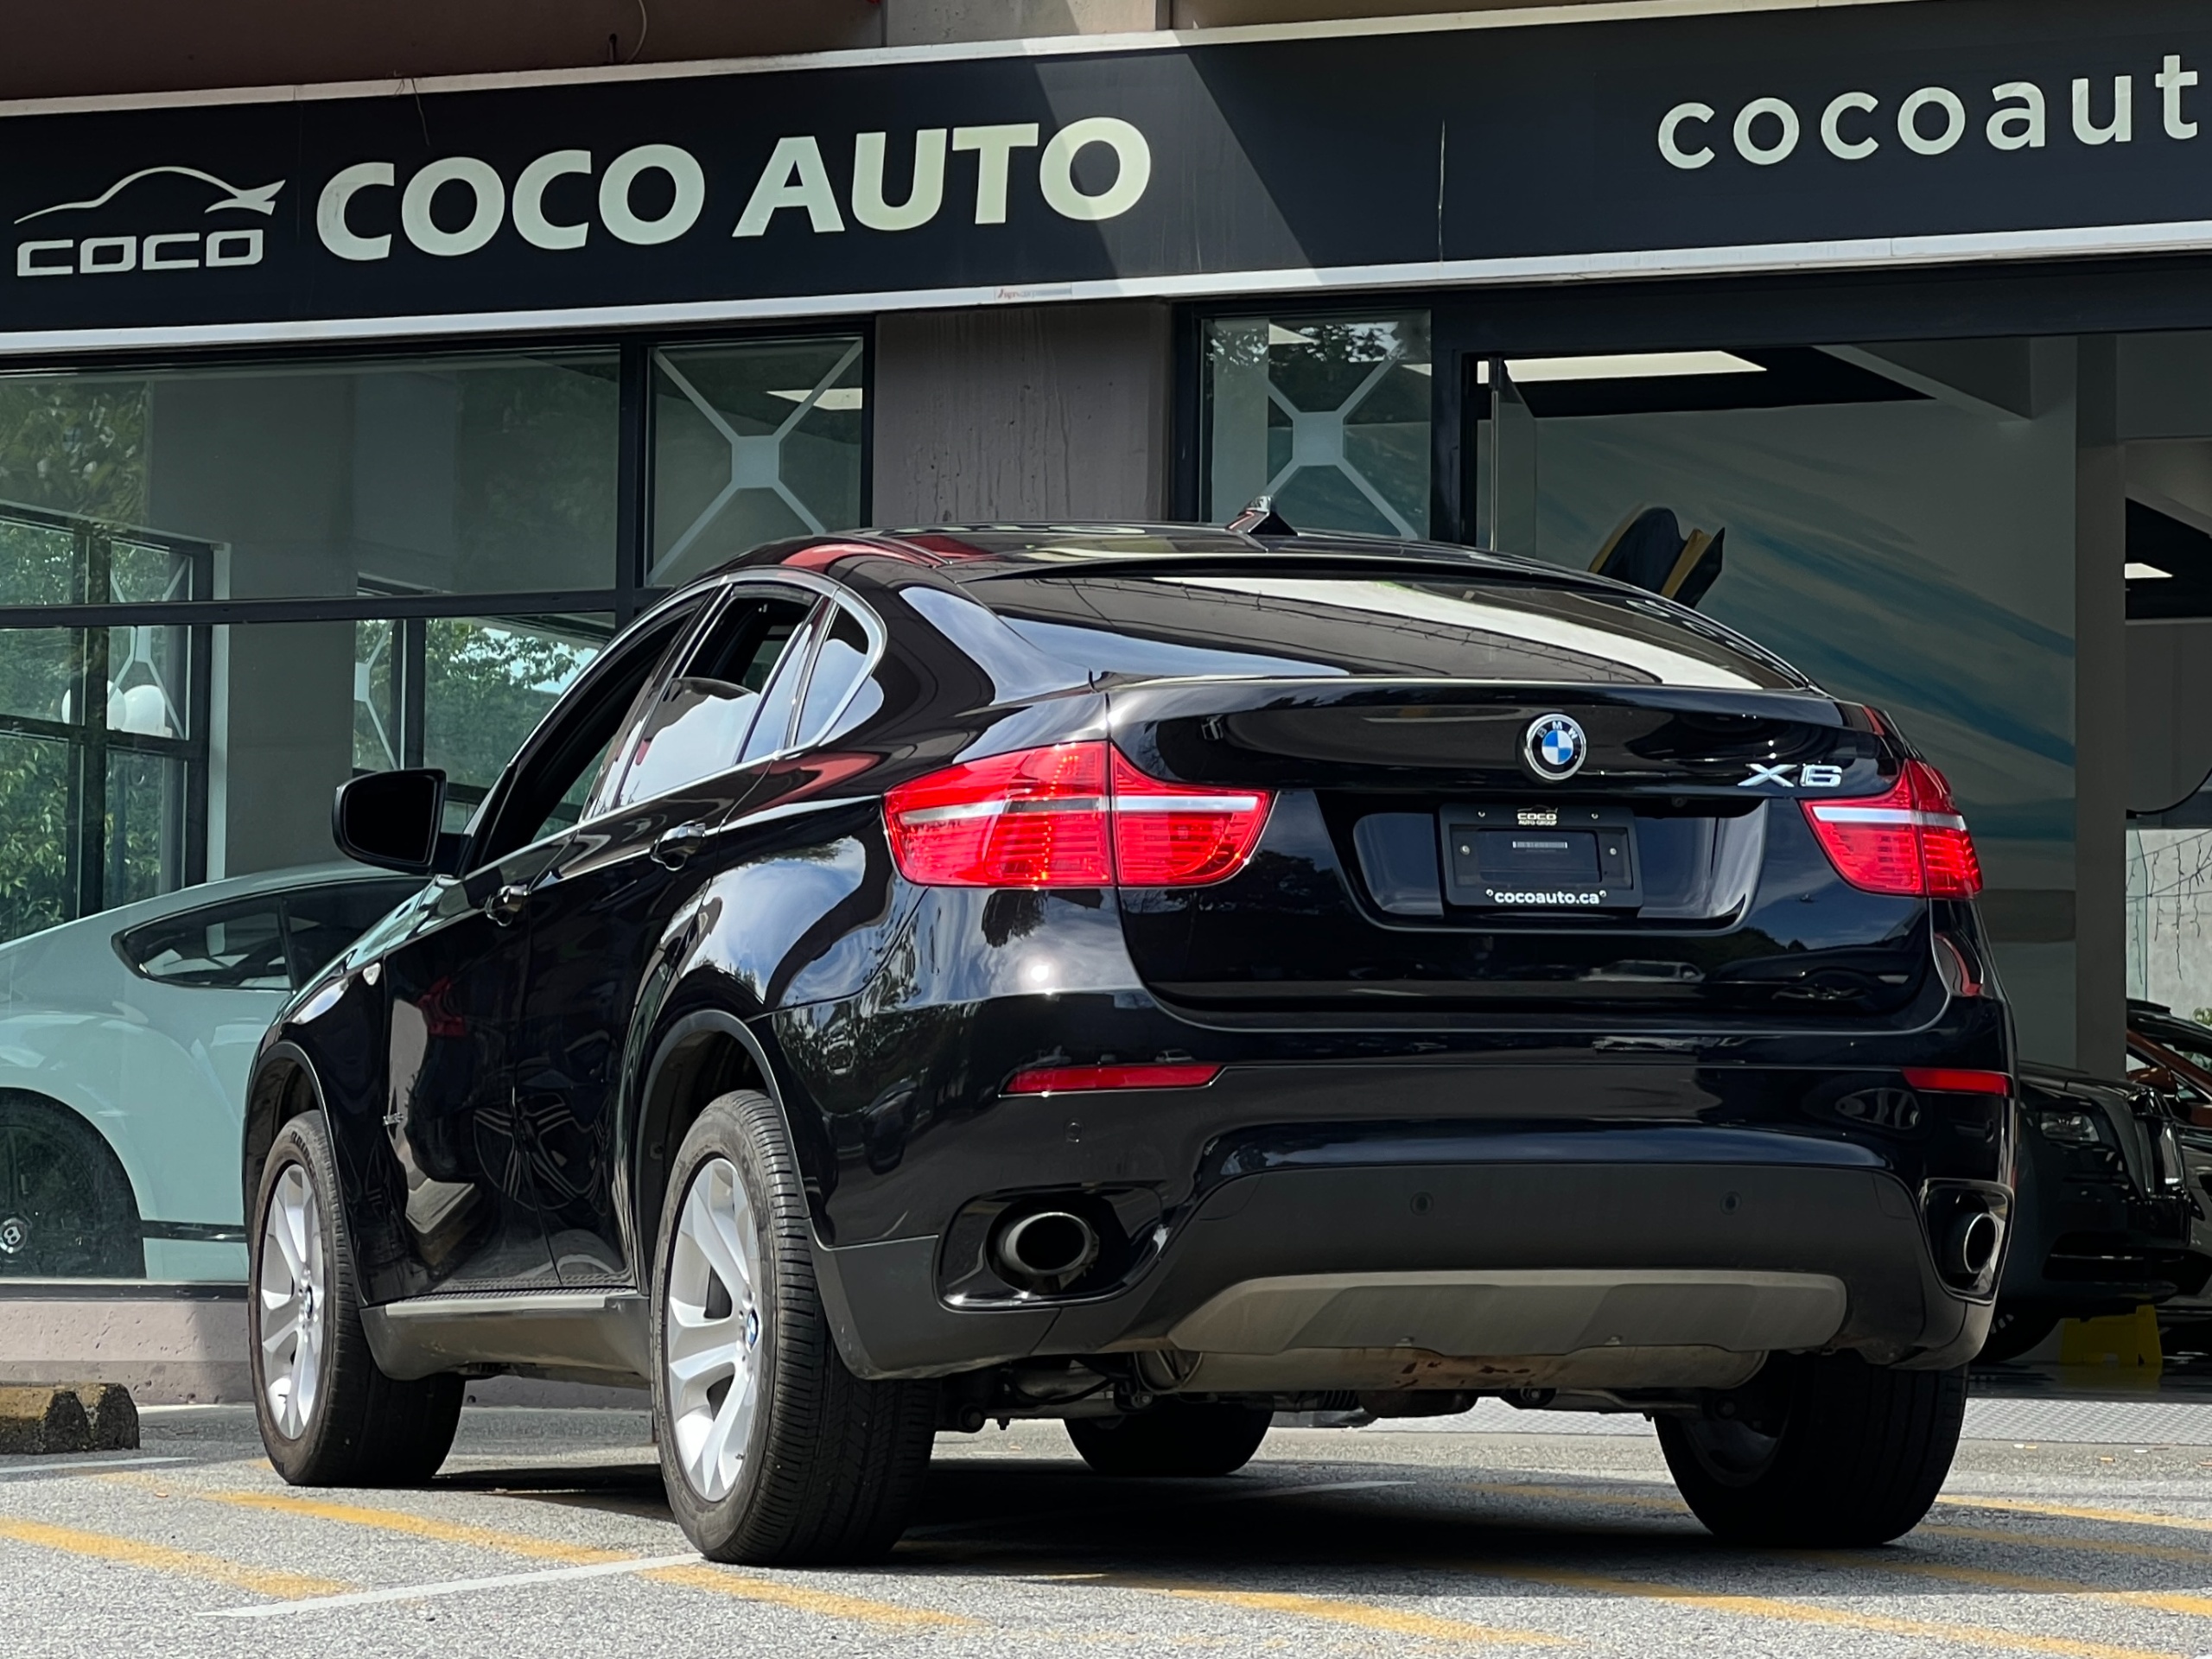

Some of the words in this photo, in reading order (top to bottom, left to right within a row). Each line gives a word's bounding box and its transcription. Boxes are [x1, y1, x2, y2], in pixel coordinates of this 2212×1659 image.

[316, 143, 706, 262] COCO
[732, 117, 1153, 238] AUTO
[16, 229, 264, 276] COCO
[1536, 720, 1579, 740] BMW
[1737, 763, 1843, 788] X6
[1516, 812, 1557, 821] COCO
[1494, 890, 1600, 905] cocoauto.ca
